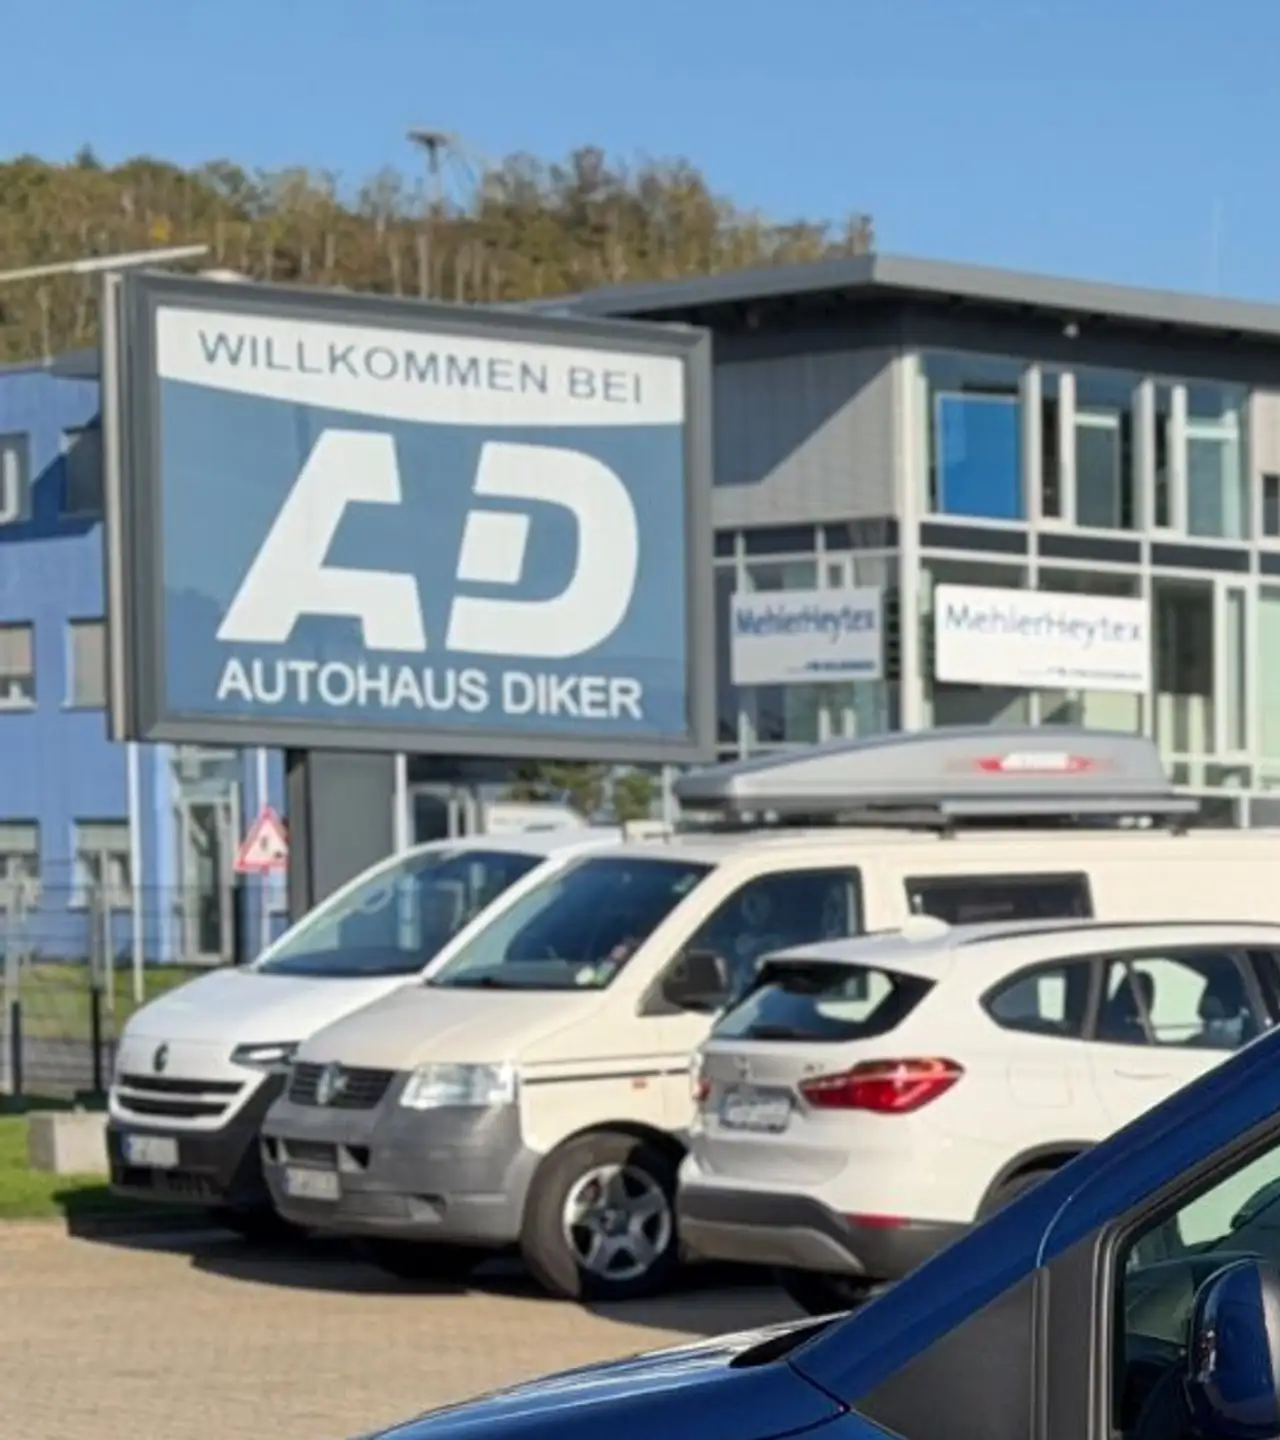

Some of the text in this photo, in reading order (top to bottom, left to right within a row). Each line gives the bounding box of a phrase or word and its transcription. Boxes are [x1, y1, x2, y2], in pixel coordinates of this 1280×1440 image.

[199, 330, 643, 405] WILLKOMMEN BEI
[216, 428, 639, 659] AD
[944, 602, 1143, 651] MehlerHeytex
[217, 657, 644, 720] AUTOHAUS DIKER
